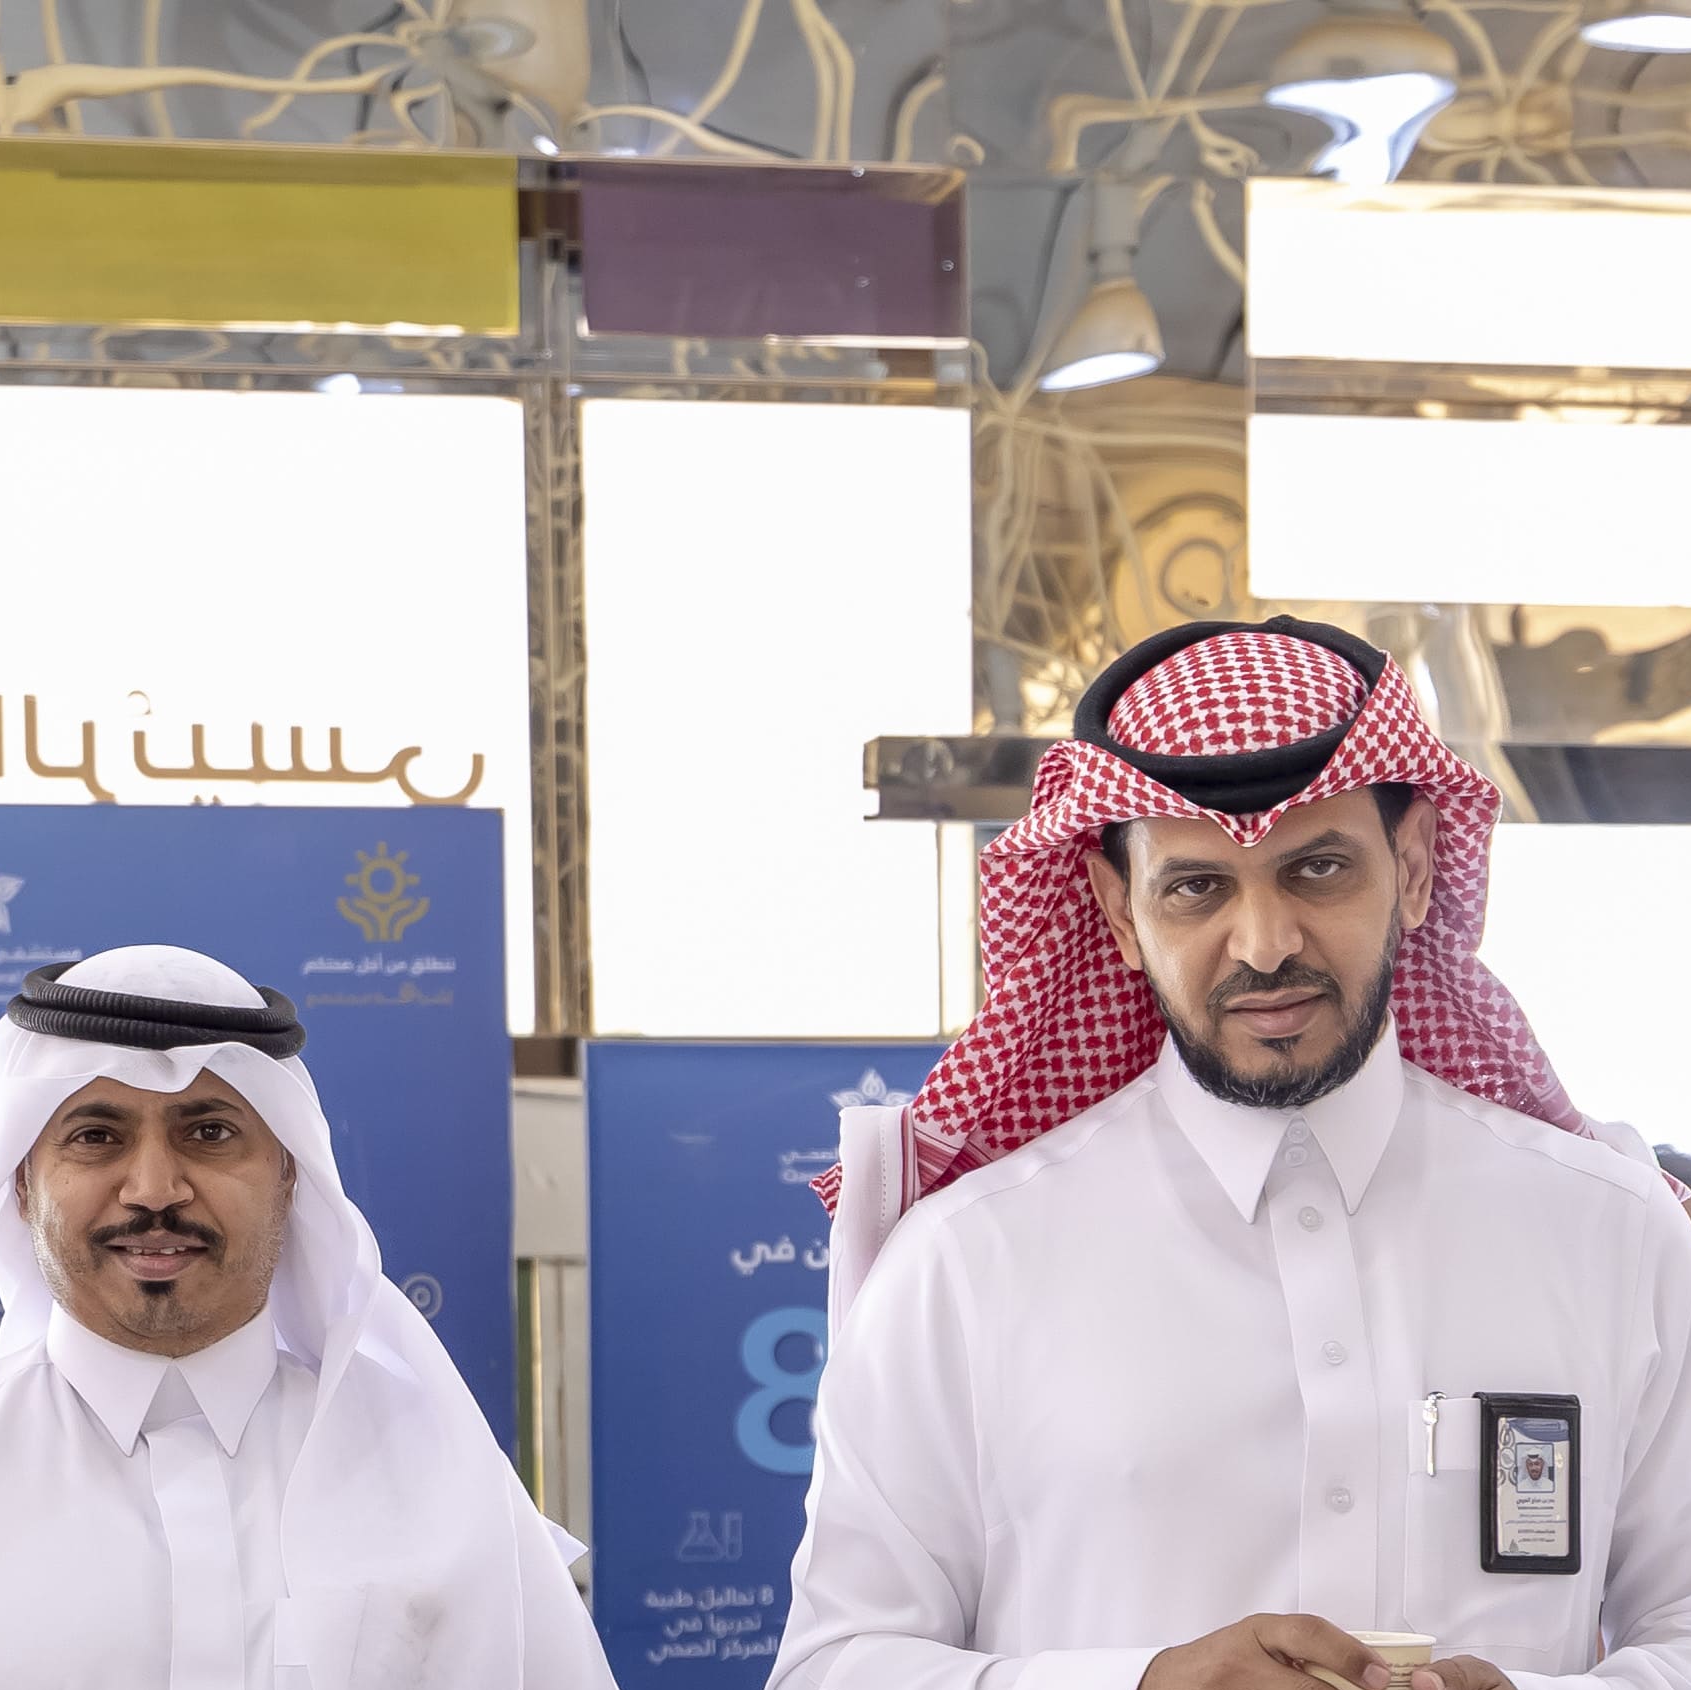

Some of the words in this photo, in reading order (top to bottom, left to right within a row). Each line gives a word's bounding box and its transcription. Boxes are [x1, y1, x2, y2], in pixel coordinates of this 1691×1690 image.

[730, 1235, 797, 1276] في
[735, 1305, 829, 1477] 8
[757, 1584, 774, 1606] 8
